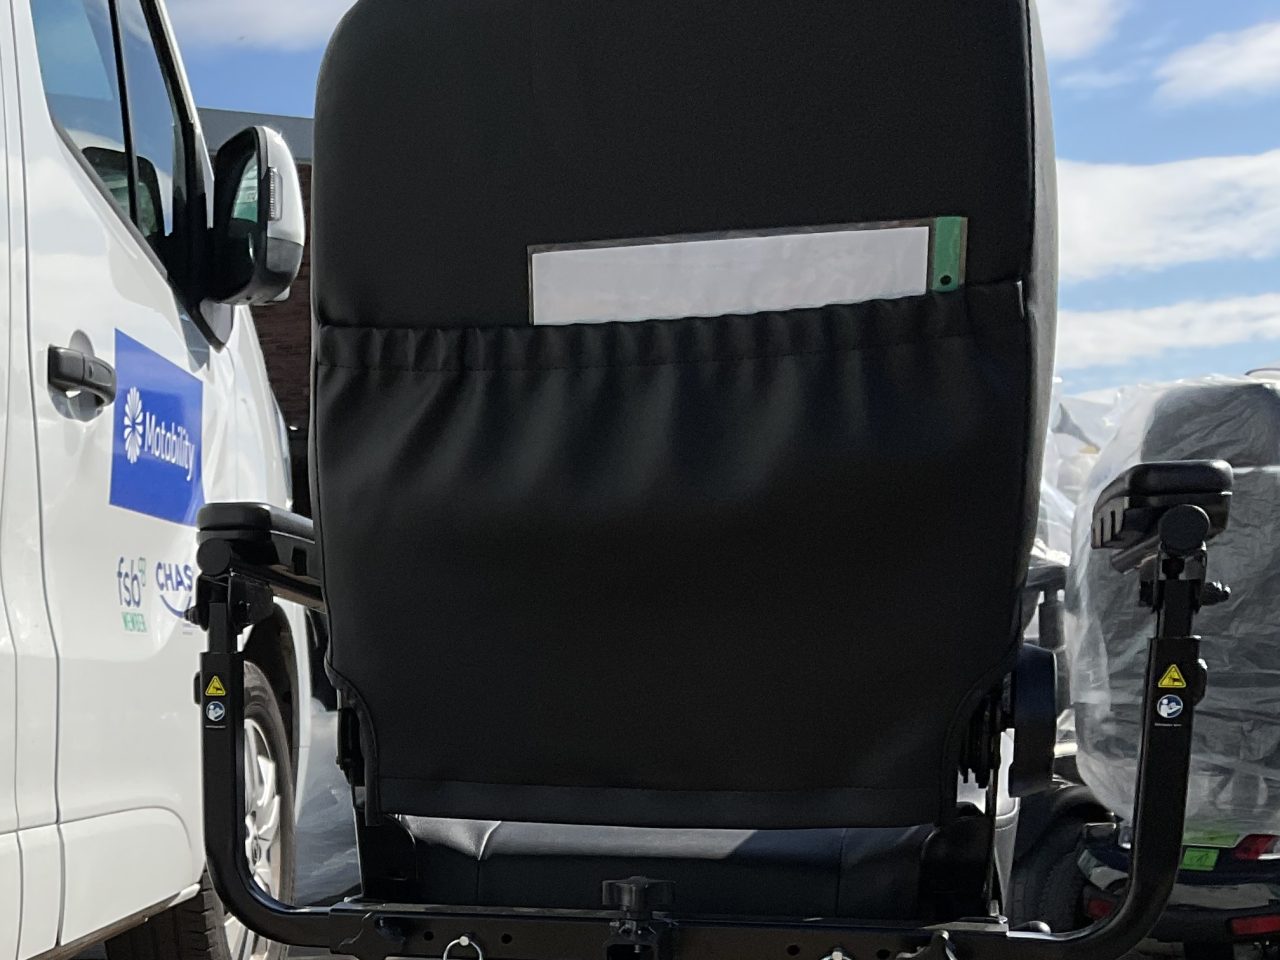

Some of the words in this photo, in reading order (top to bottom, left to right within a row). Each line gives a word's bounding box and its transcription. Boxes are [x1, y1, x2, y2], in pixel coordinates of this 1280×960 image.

[144, 411, 195, 482] Motability
[117, 556, 141, 608] fsb
[156, 562, 193, 592] CHAS
